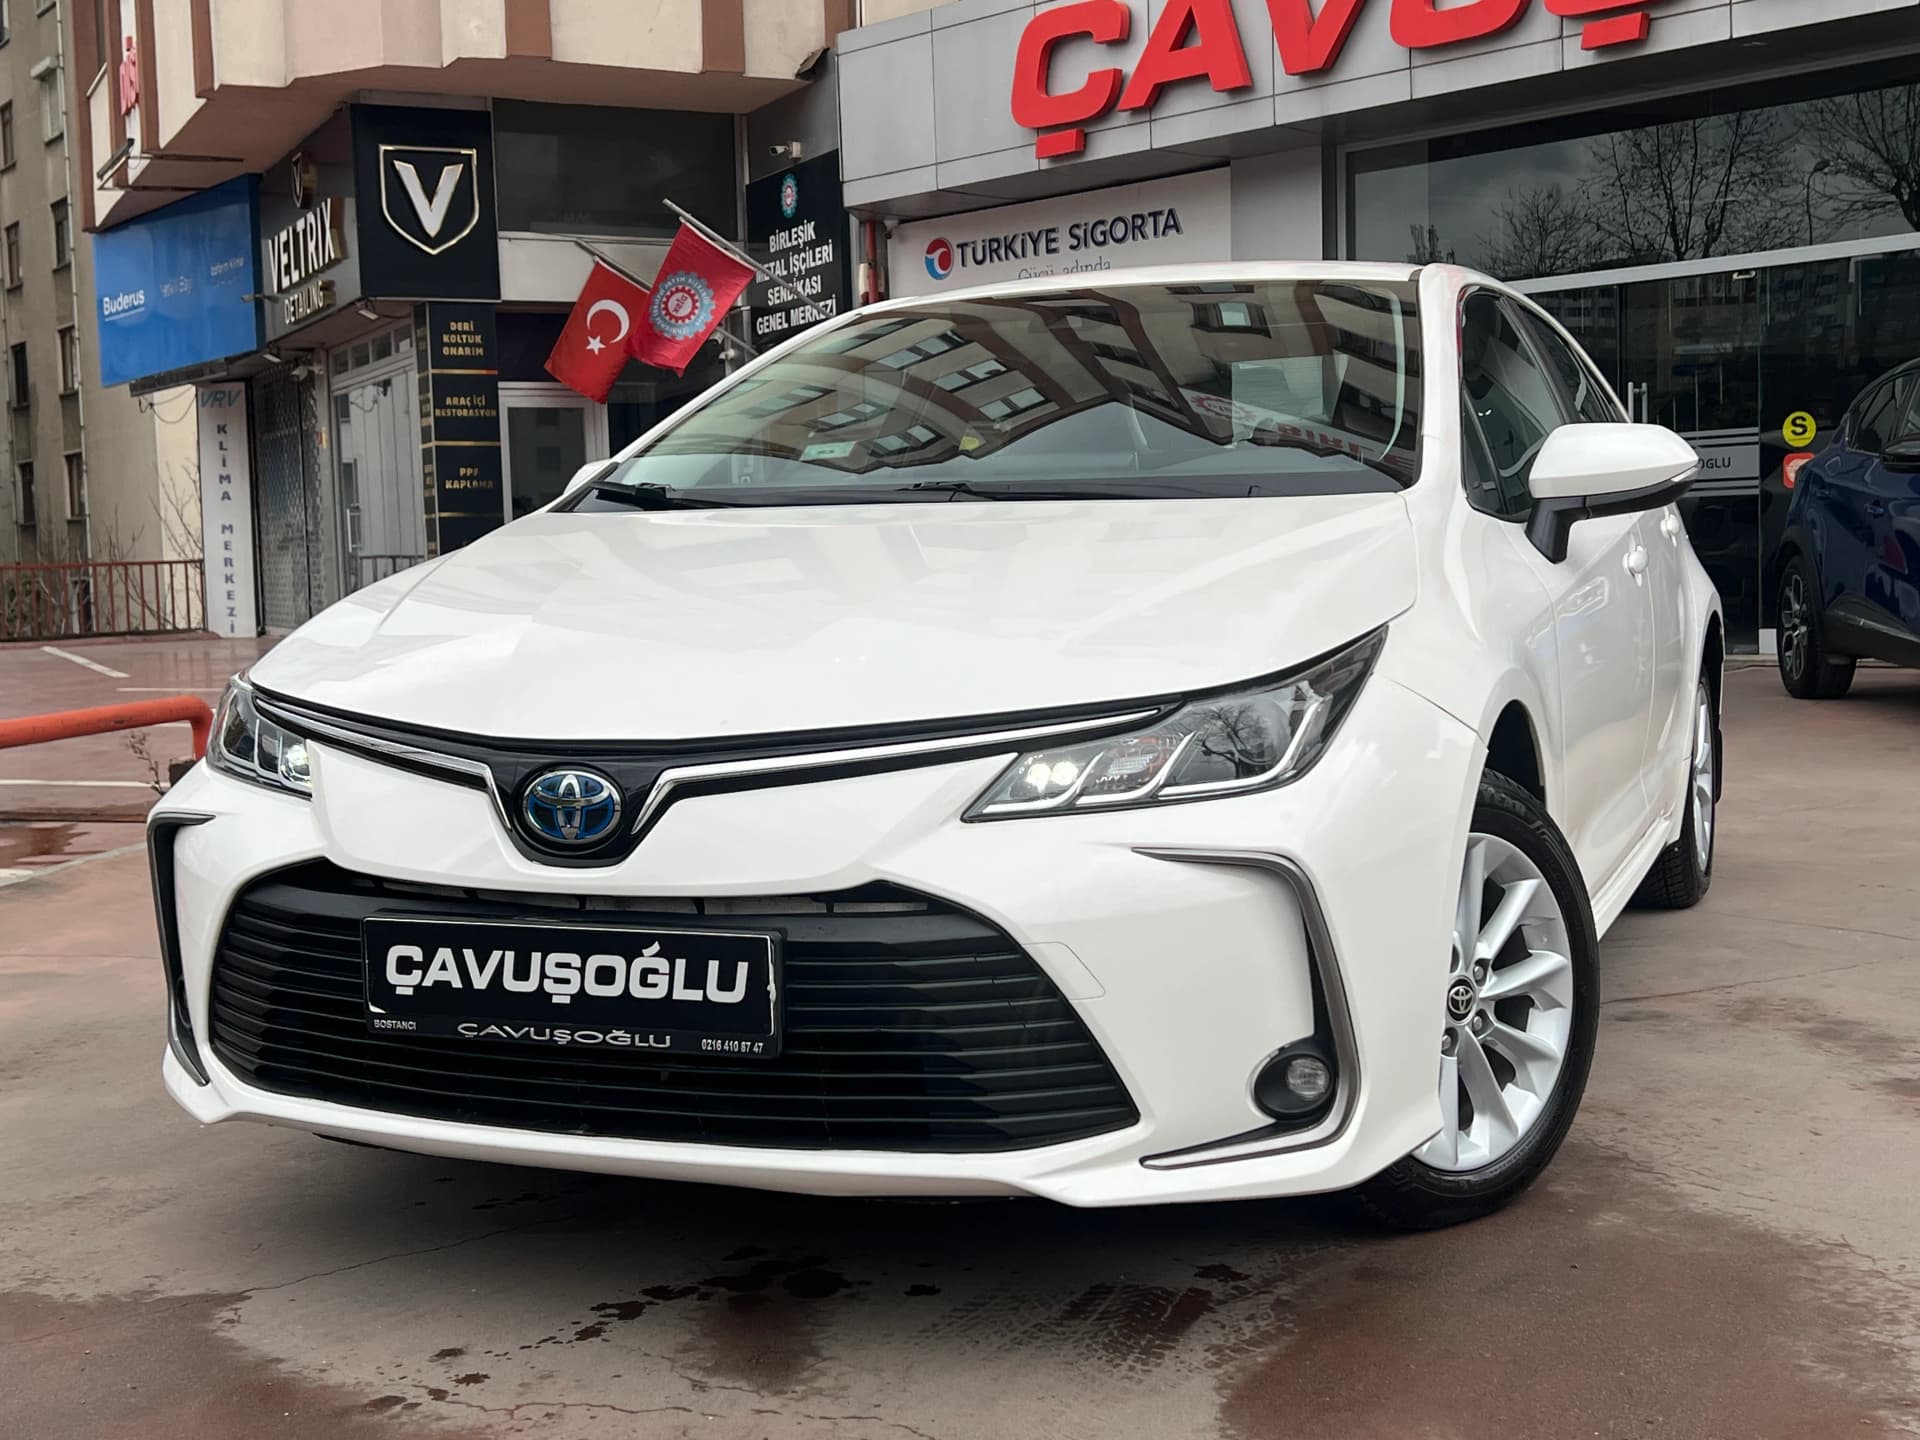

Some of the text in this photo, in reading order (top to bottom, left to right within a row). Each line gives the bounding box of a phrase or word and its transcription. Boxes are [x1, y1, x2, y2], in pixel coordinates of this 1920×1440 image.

[393, 160, 464, 238] V
[268, 197, 335, 294] VELTRIX
[769, 219, 816, 253] BİRLEŞİK
[789, 239, 833, 277] İŞÇİLERİ
[103, 289, 145, 316] Buderus
[284, 279, 324, 324] DETAILING
[756, 293, 837, 335] GENEL MERKEZİ
[450, 320, 474, 331] DERİ
[442, 334, 482, 344] KOLTUK
[442, 346, 483, 356] ONARIM
[200, 390, 241, 408] VRV
[435, 409, 497, 417] RESTORASYON
[1791, 416, 1808, 436] S
[459, 467, 479, 477] PPF
[386, 941, 749, 1004] ÇAVUŞOĞLU
[374, 1019, 416, 1030] BOSTANCI
[457, 1023, 671, 1047] ÇAVUŞOĞLU
[701, 1038, 721, 1051] 0216
[723, 1040, 738, 1052] 410
[753, 1042, 764, 1054] 47
